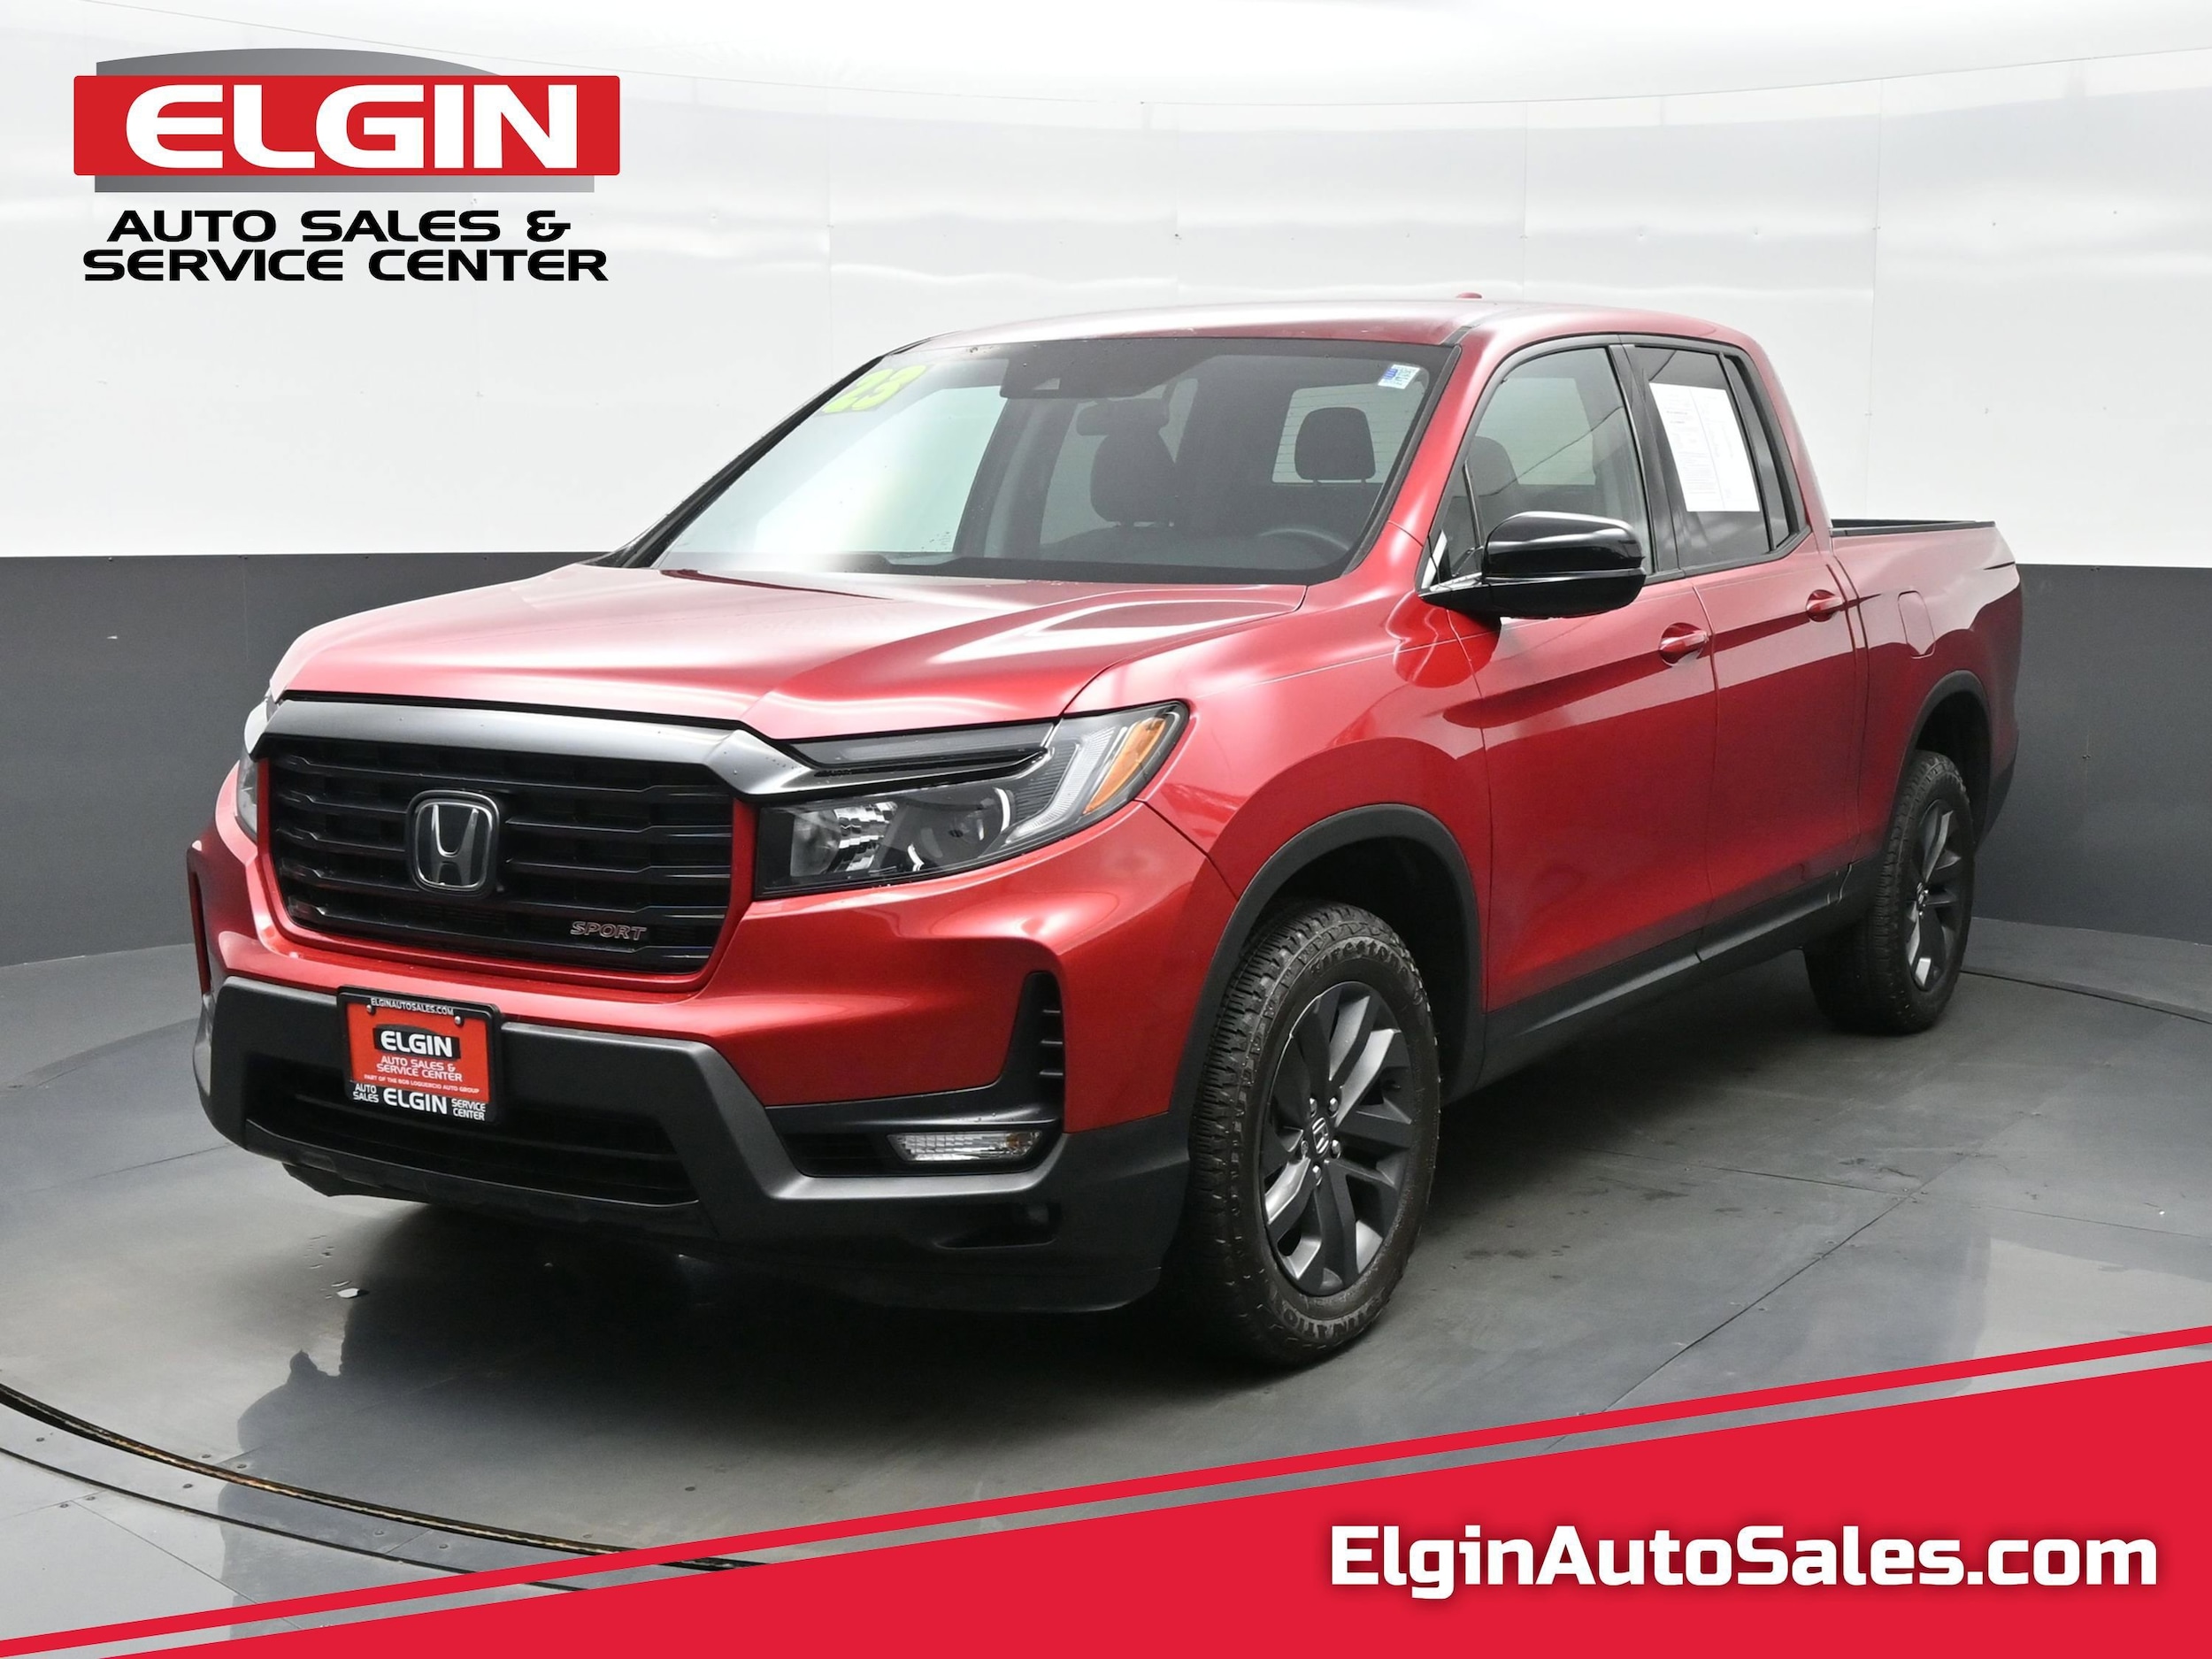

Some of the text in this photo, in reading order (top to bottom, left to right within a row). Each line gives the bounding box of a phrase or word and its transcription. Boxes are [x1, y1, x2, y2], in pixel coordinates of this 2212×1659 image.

[570, 921, 647, 941] SPORT
[371, 997, 454, 1016] ELGINAUTOSALES.COM
[380, 1030, 453, 1058] ELGIN
[380, 1055, 456, 1072] AUTO SALES &
[376, 1064, 463, 1082] SERVICE CENTER
[353, 1091, 379, 1103] SALES
[355, 1083, 377, 1094] AUTO
[383, 1087, 448, 1115] ELGIN
[451, 1098, 486, 1112] SERVICE
[453, 1108, 485, 1121] CENTER
